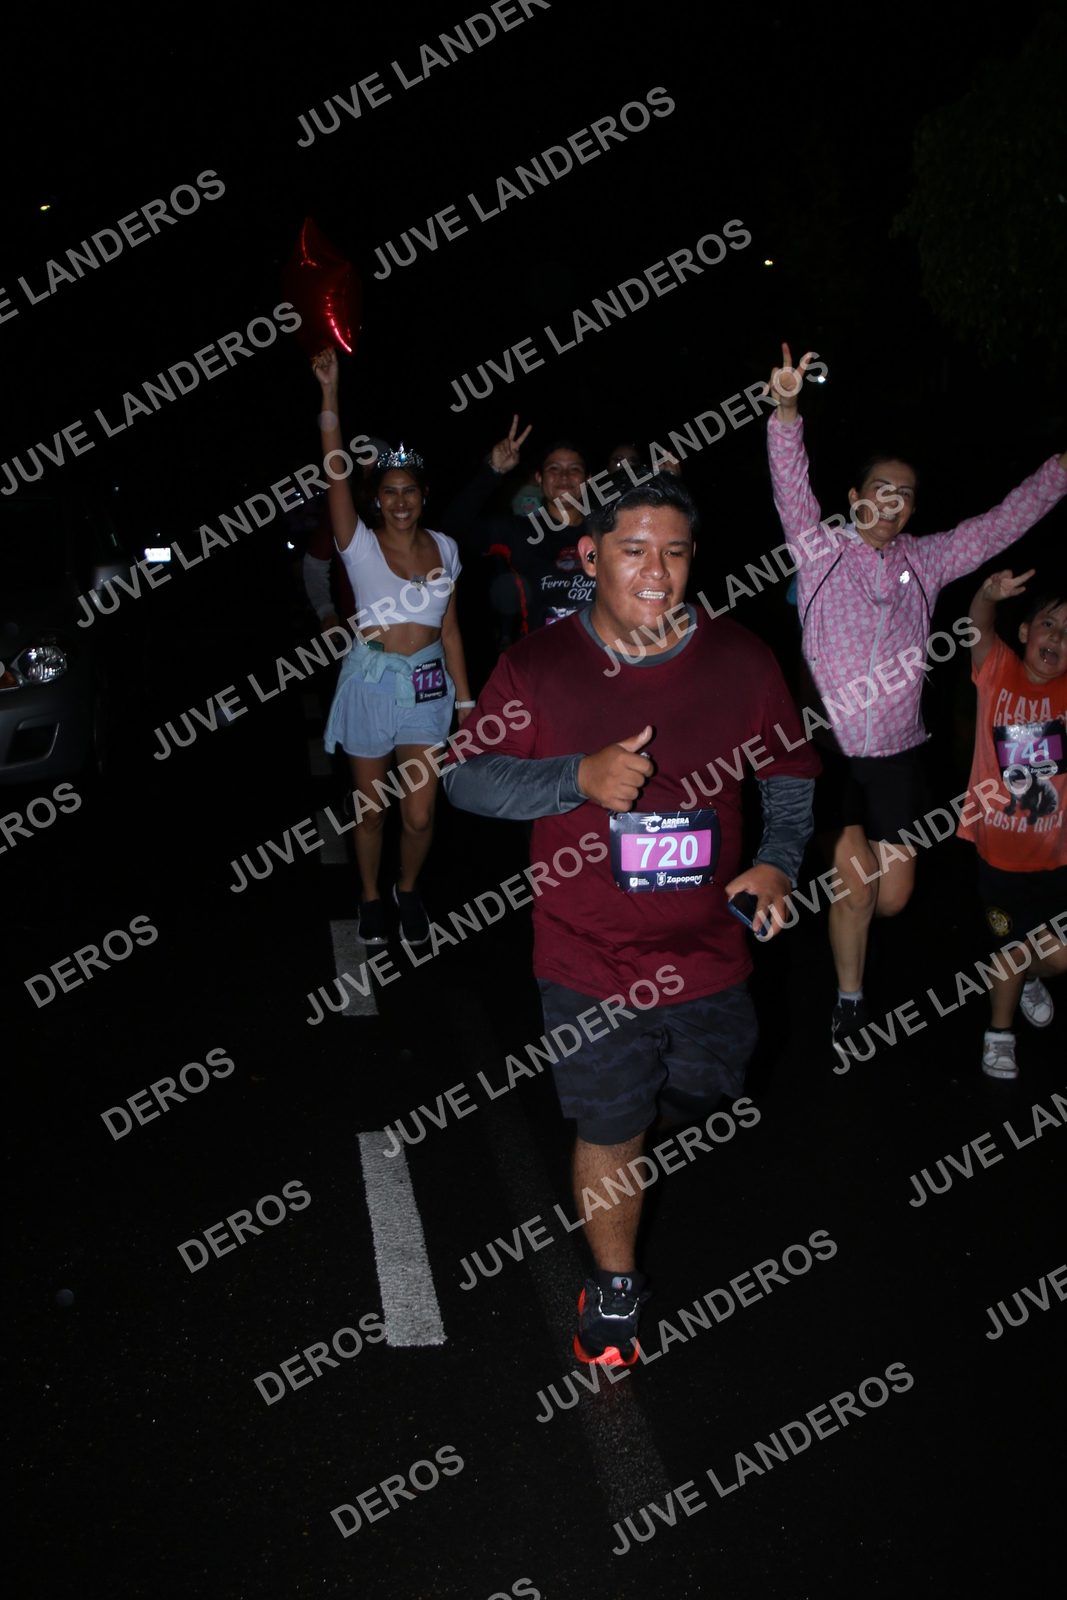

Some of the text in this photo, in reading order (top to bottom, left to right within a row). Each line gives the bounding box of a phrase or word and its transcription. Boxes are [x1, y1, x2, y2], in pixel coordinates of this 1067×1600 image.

[541, 575, 571, 591] Ferro
[567, 587, 593, 602] GDL
[1004, 738, 1049, 765] 741
[984, 808, 1028, 833] COSTA
[636, 834, 699, 869] 720
